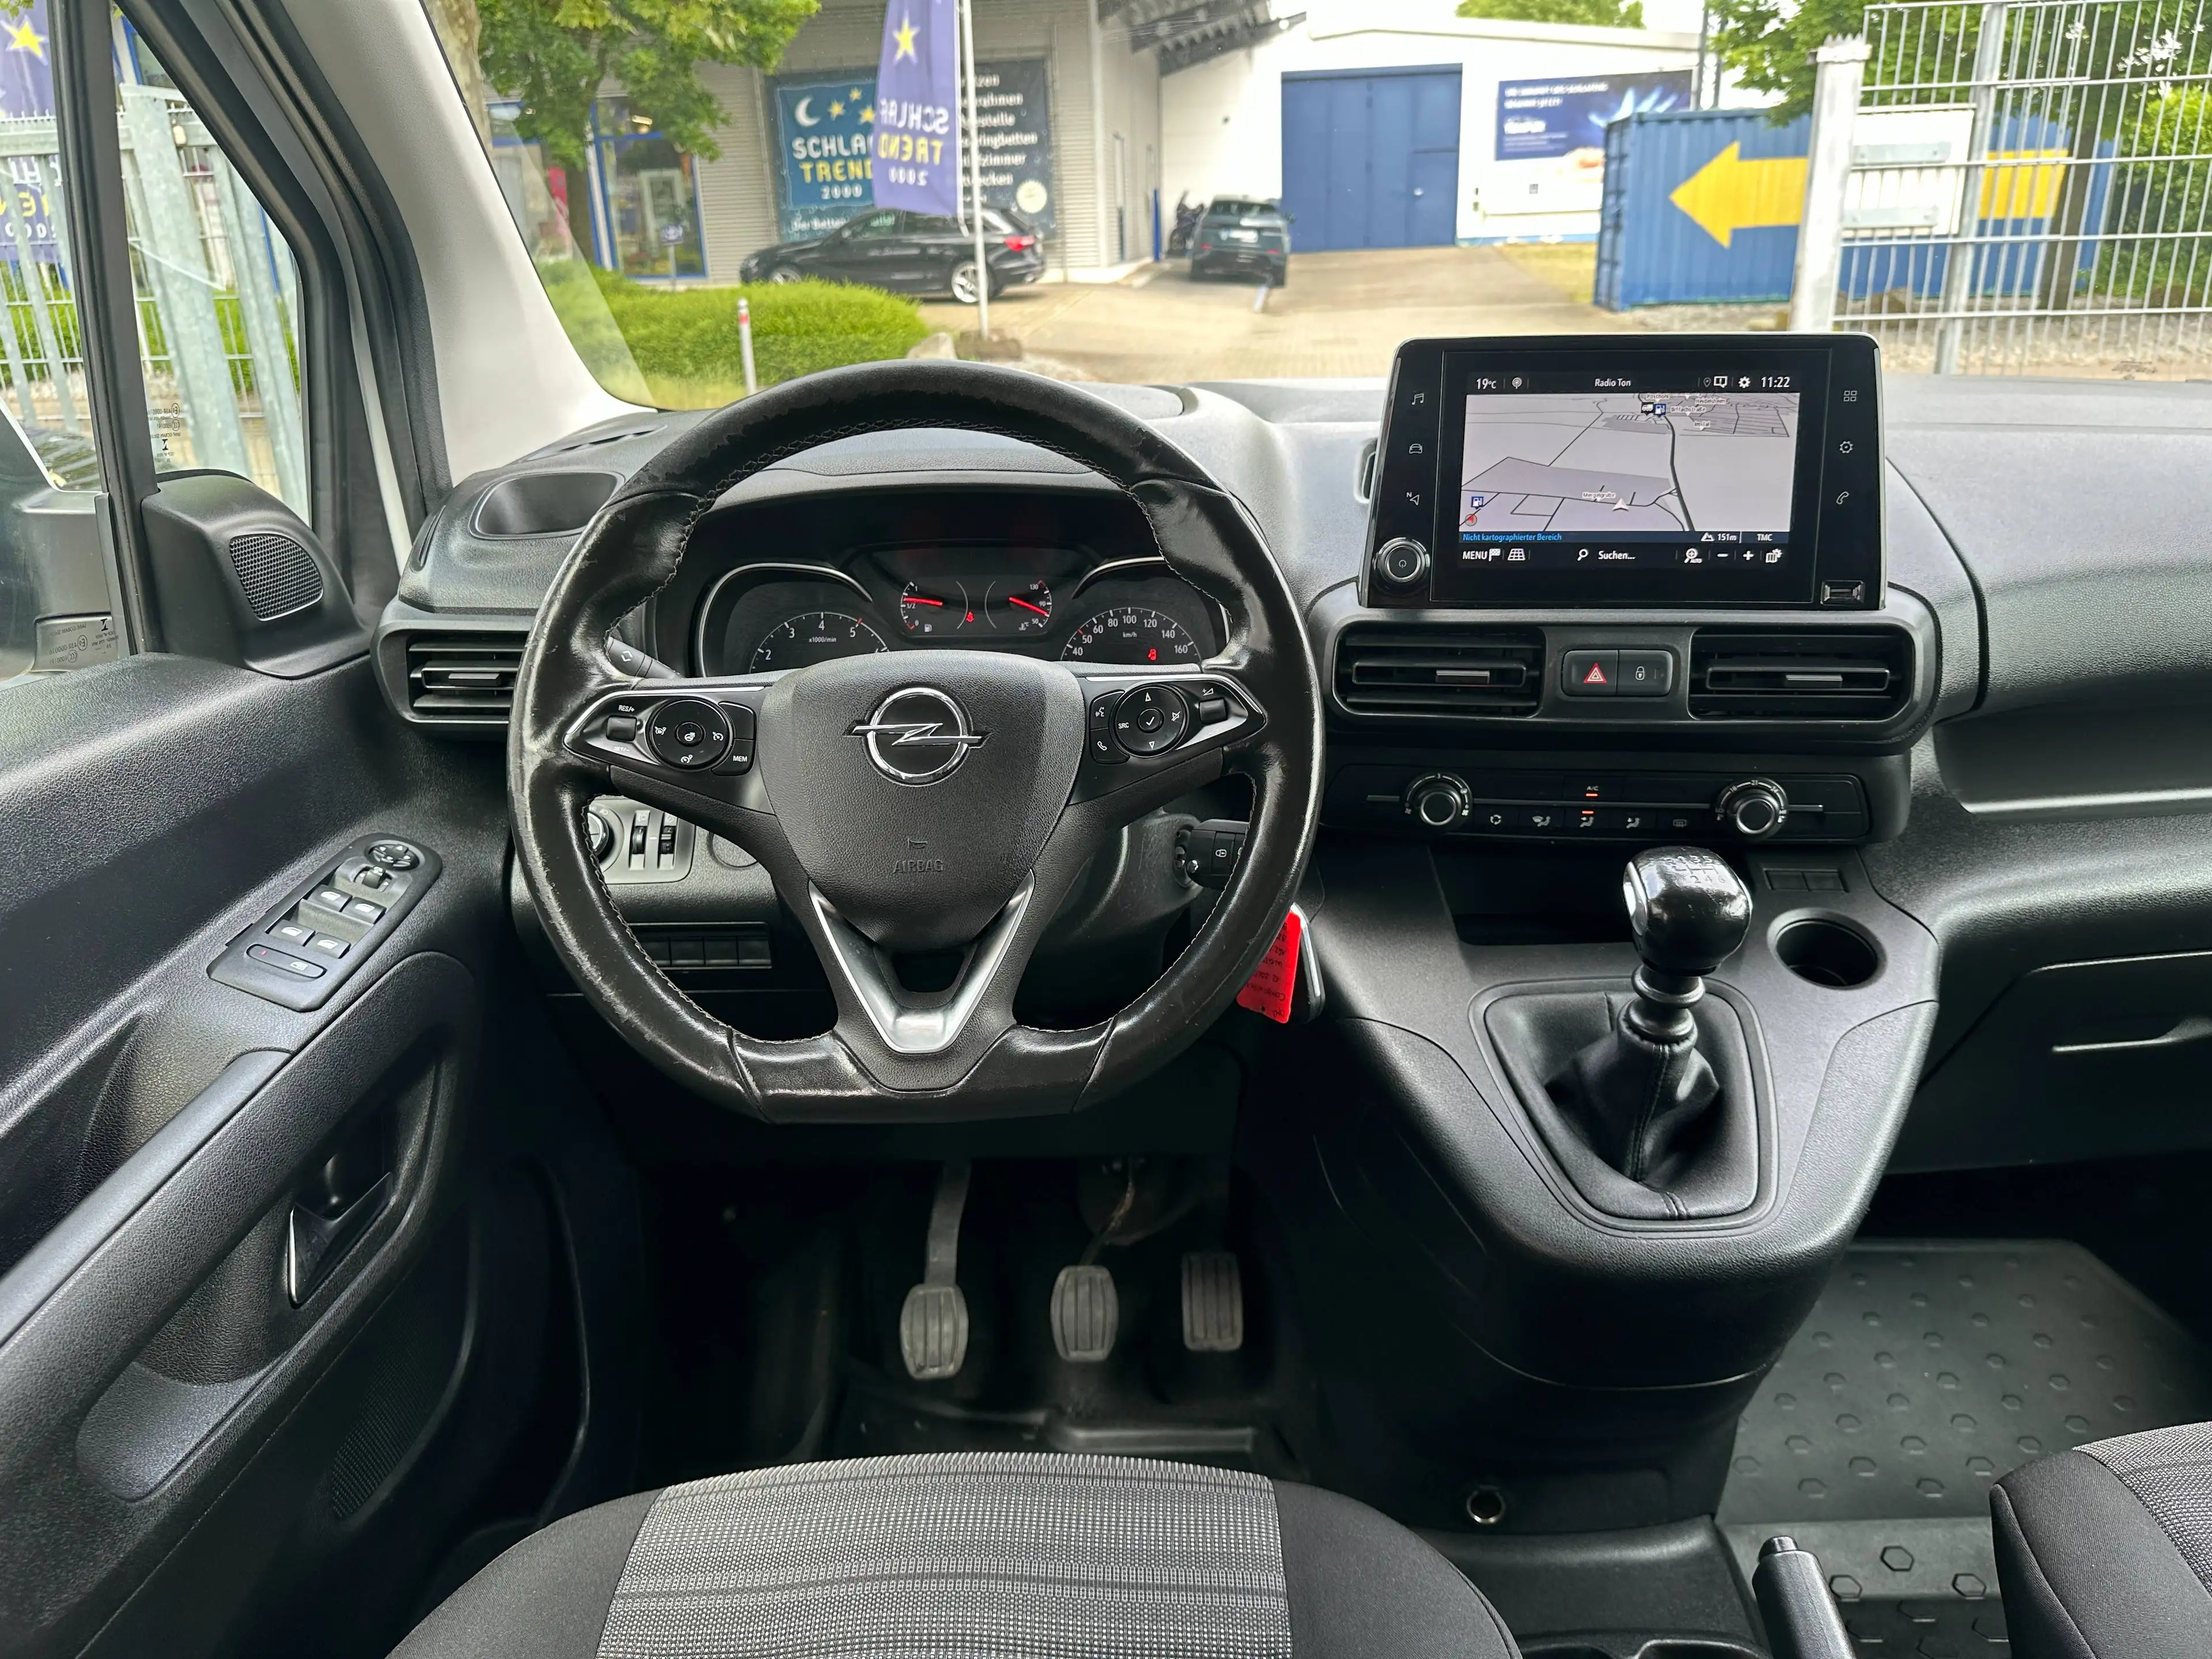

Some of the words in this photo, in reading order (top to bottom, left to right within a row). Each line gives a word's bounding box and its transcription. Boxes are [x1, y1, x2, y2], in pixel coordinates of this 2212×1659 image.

[791, 132, 873, 159] SCHLA
[820, 183, 863, 200] 2000
[1476, 377, 1497, 389] 19°C
[1594, 378, 1616, 387] Radio
[1617, 378, 1631, 387] Ton
[1761, 376, 1790, 388] 11:22
[1482, 533, 1535, 541] kartographierter
[1462, 551, 1487, 559] MENU
[1108, 618, 1118, 627] 80
[1123, 615, 1137, 624] 100
[1143, 619, 1157, 628] 120
[818, 620, 825, 631] 4
[1093, 625, 1103, 634] 60
[789, 628, 795, 638] 3
[850, 627, 855, 637] 5
[1161, 630, 1175, 639] 140
[1082, 635, 1092, 644] 50
[1073, 647, 1083, 656] 40
[1174, 645, 1188, 654] 160
[766, 649, 771, 661] 2
[618, 704, 635, 713] RES/+
[1690, 855, 1700, 863] 3
[893, 859, 944, 873] AIRBAG
[1690, 876, 1701, 884] 2
[1705, 875, 1713, 883] 4
